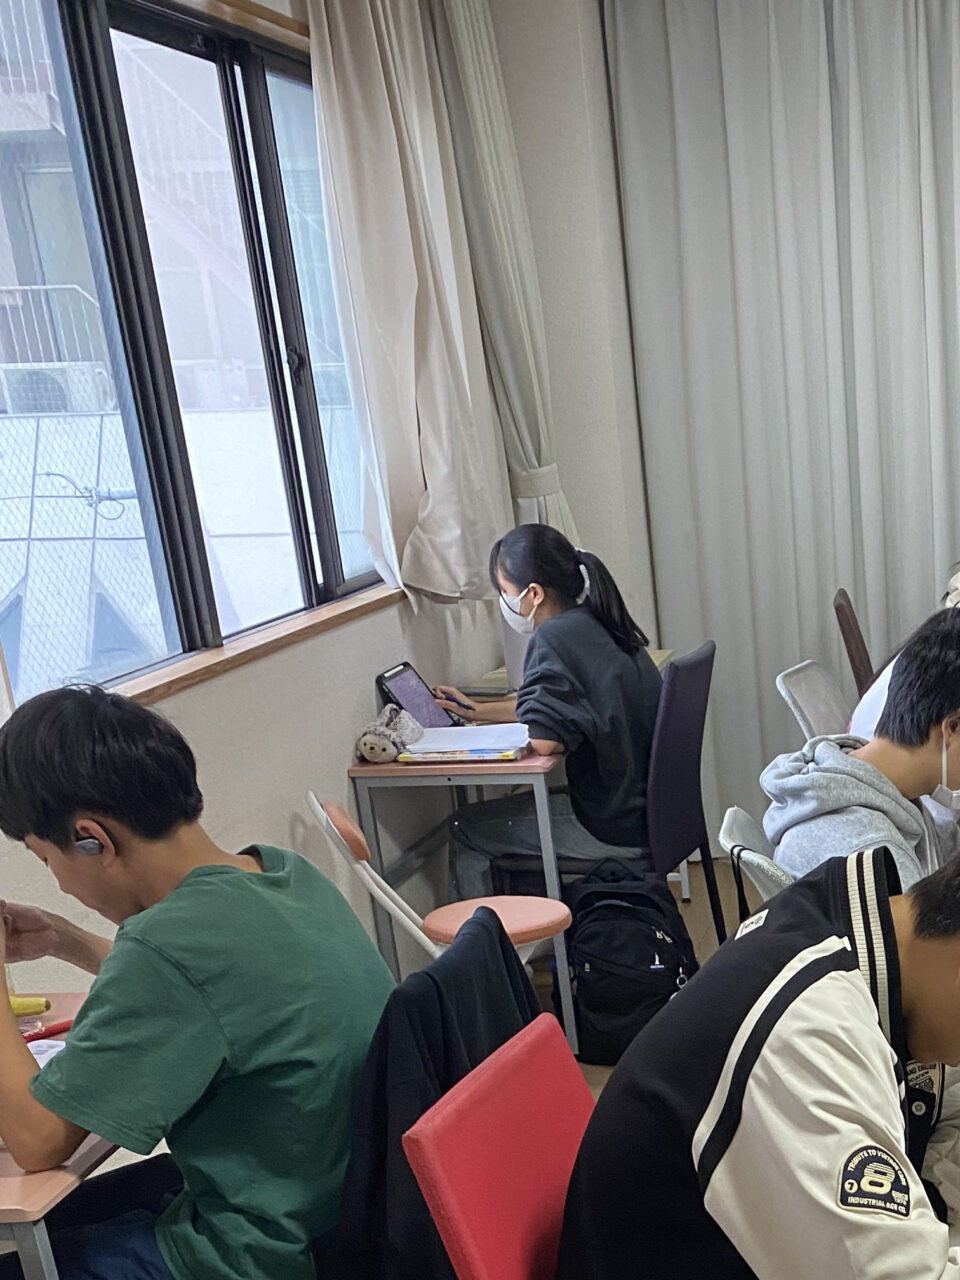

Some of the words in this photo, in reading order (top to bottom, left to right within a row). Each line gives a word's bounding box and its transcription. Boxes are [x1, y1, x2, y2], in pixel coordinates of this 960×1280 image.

[847, 1150, 868, 1172] TRIBUTE
[867, 1149, 877, 1157] TO
[848, 1196, 886, 1207] INDUSTRIAL
